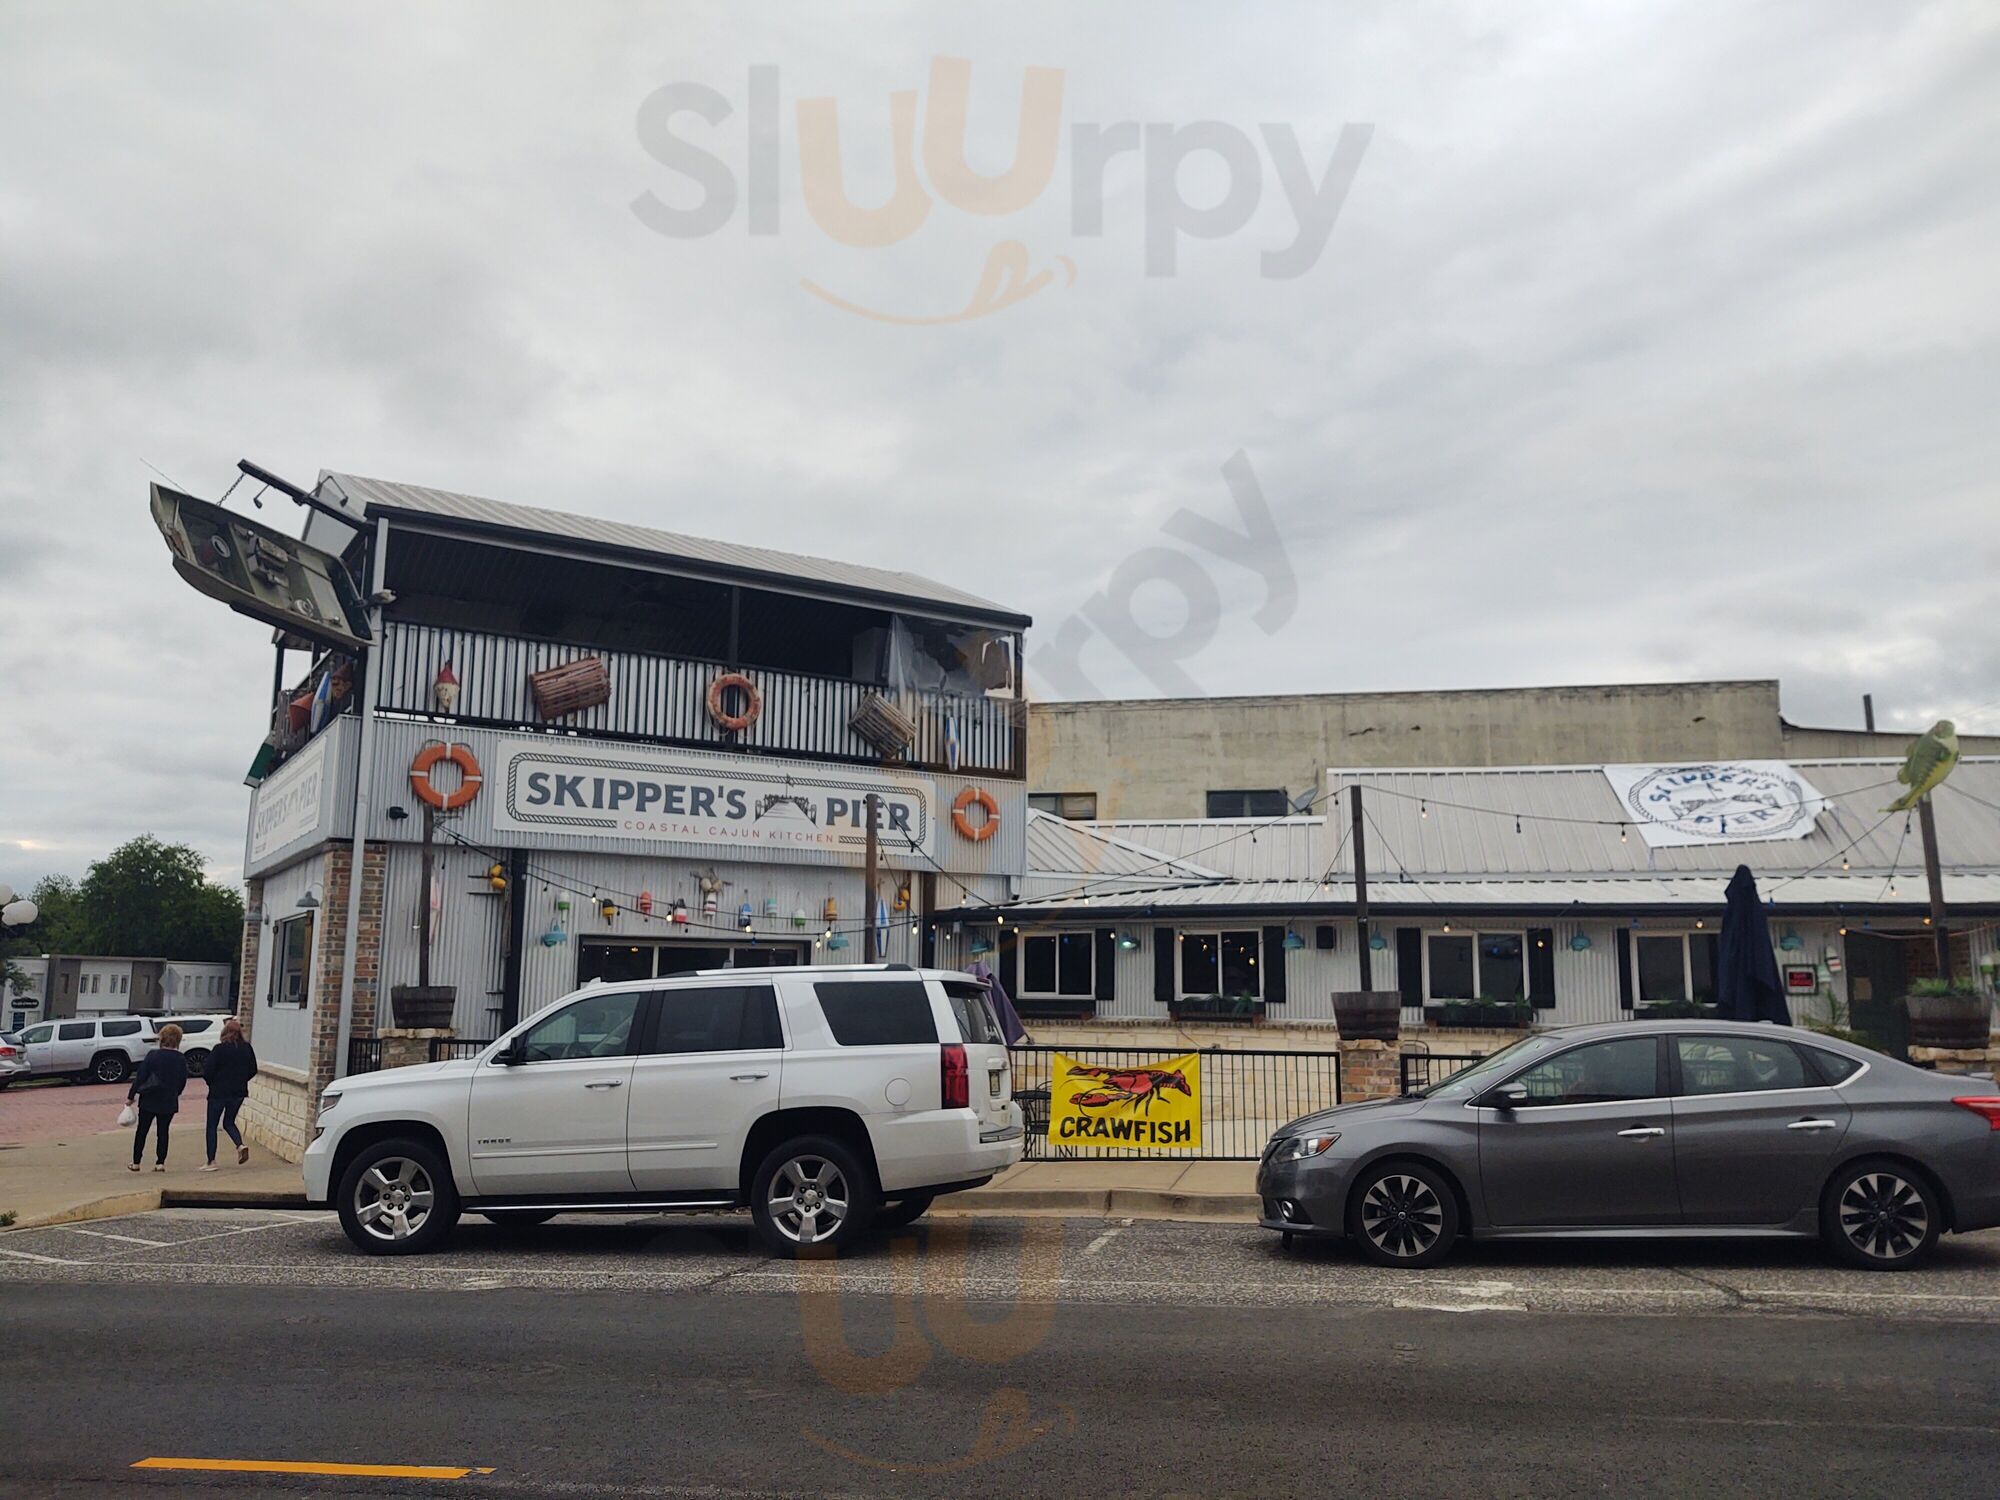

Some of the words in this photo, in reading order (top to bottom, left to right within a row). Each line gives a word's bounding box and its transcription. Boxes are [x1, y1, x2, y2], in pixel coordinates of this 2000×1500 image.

[526, 772, 748, 820] SKIPPER'S
[624, 820, 699, 835] COASTAL
[708, 826, 760, 839] CAJUN
[769, 831, 834, 843] KITCHEN
[1059, 1116, 1192, 1144] CRAWFISH
